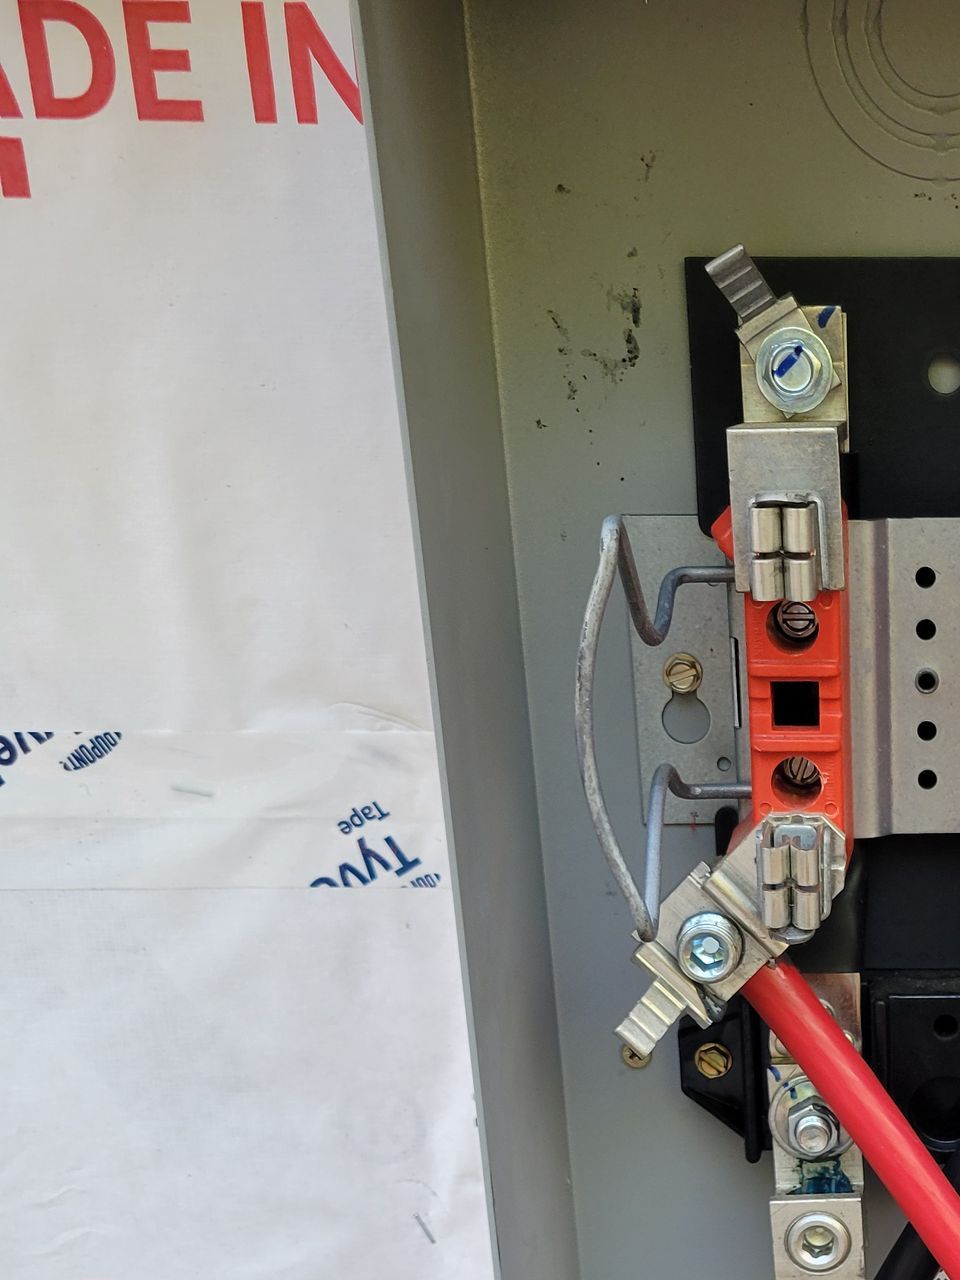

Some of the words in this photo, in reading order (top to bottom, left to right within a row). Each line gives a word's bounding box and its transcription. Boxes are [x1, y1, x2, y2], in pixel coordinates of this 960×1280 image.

[0, 0, 204, 122] DE
[66, 732, 119, 772] DUPONT
[337, 801, 391, 836] Tape
